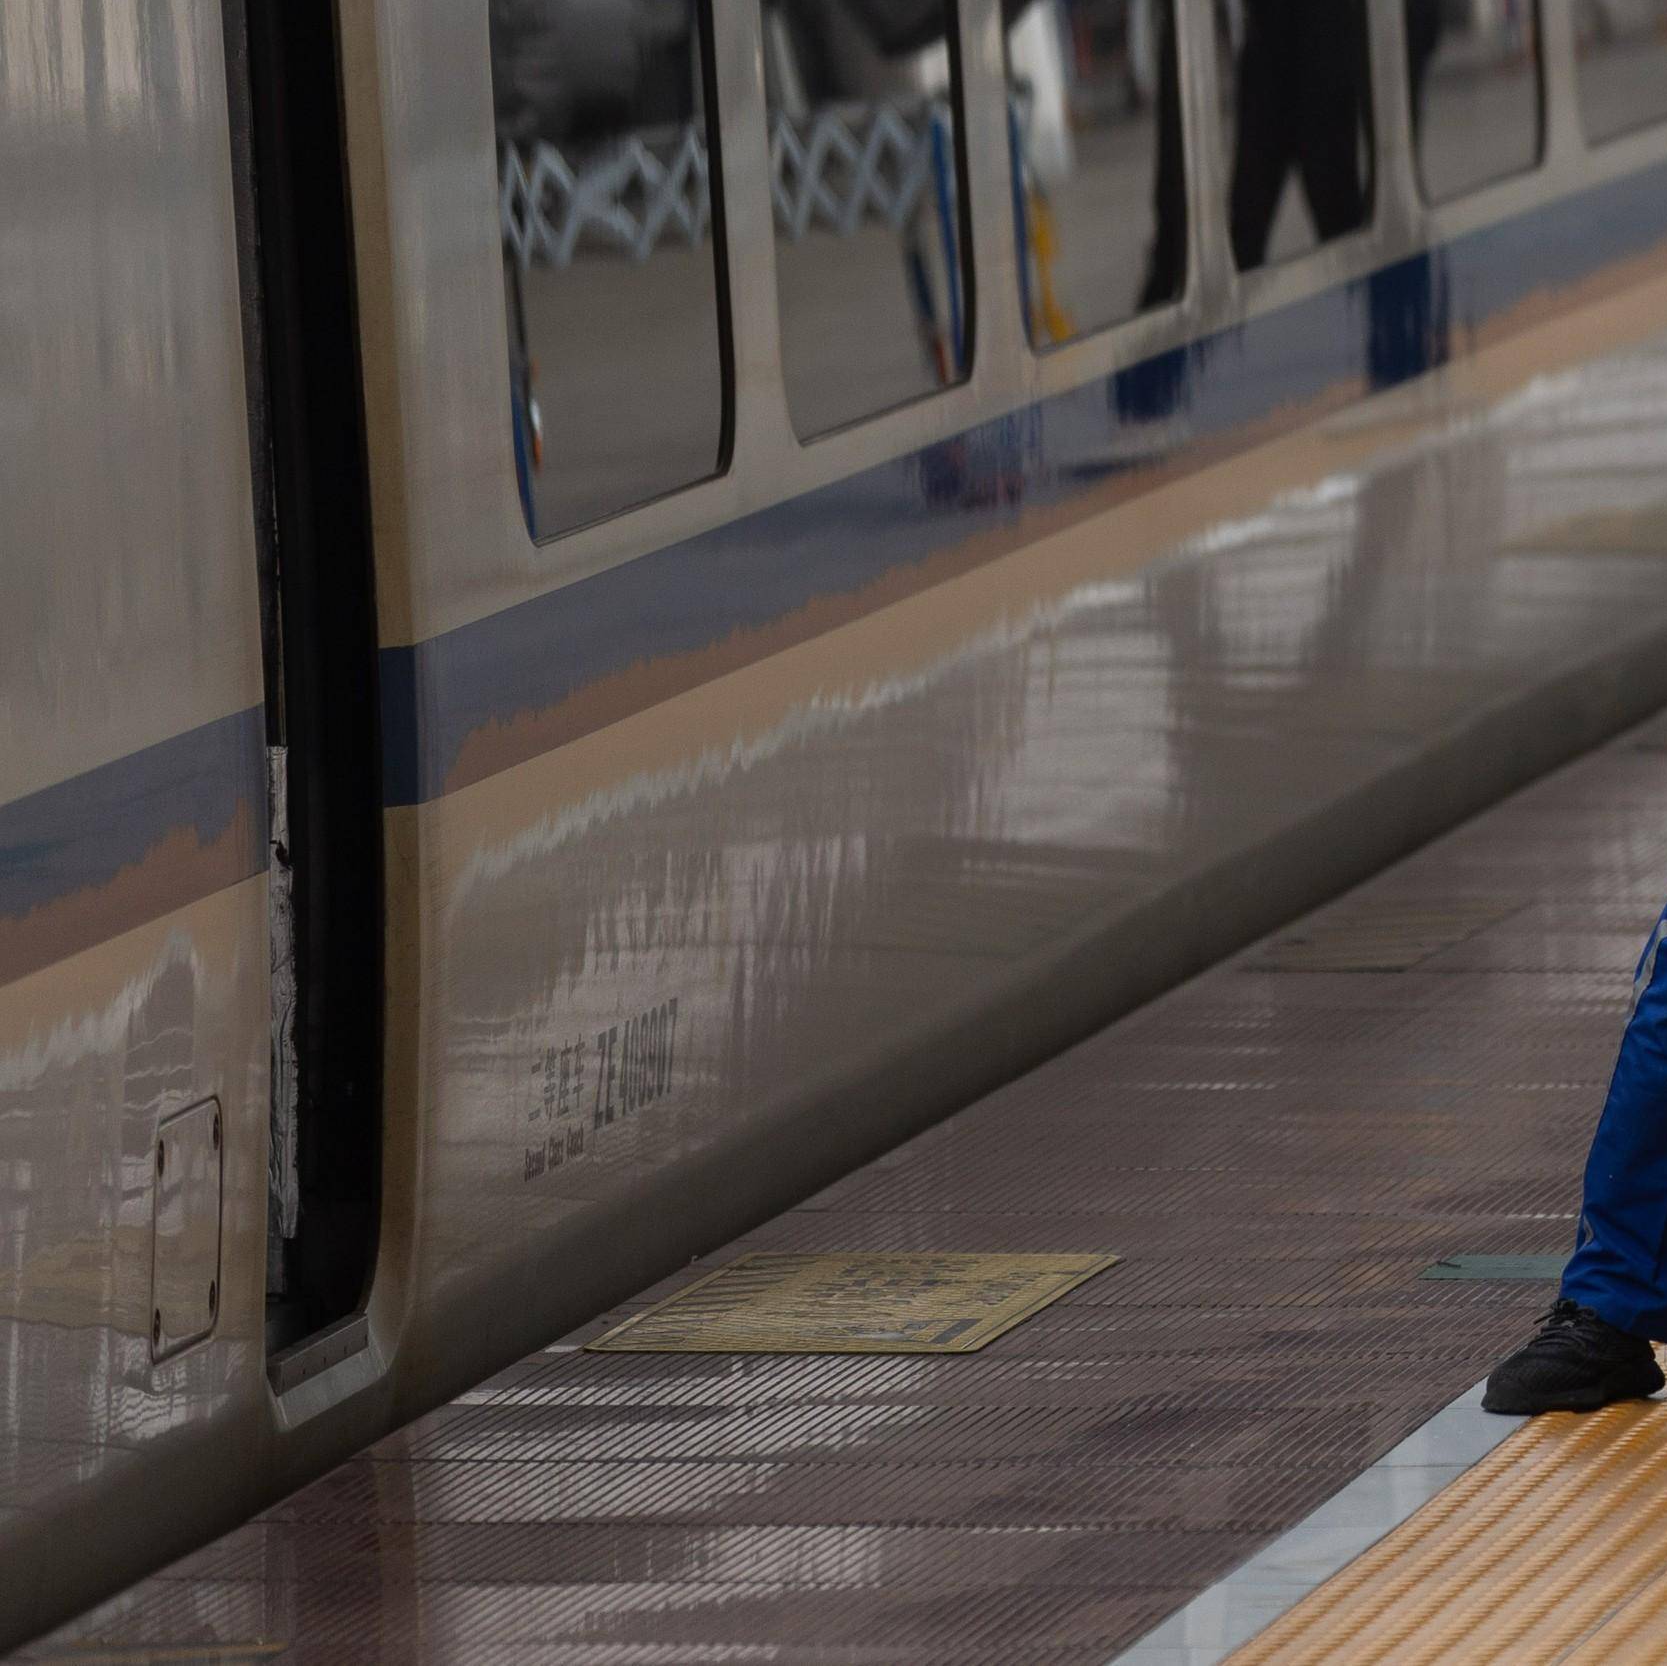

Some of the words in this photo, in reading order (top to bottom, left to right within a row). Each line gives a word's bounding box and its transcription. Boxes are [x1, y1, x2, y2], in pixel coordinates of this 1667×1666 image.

[527, 1033, 586, 1122] 二等座车
[594, 1026, 618, 1130] ZE
[524, 1140, 546, 1183] Second
[547, 1136, 564, 1170] Class
